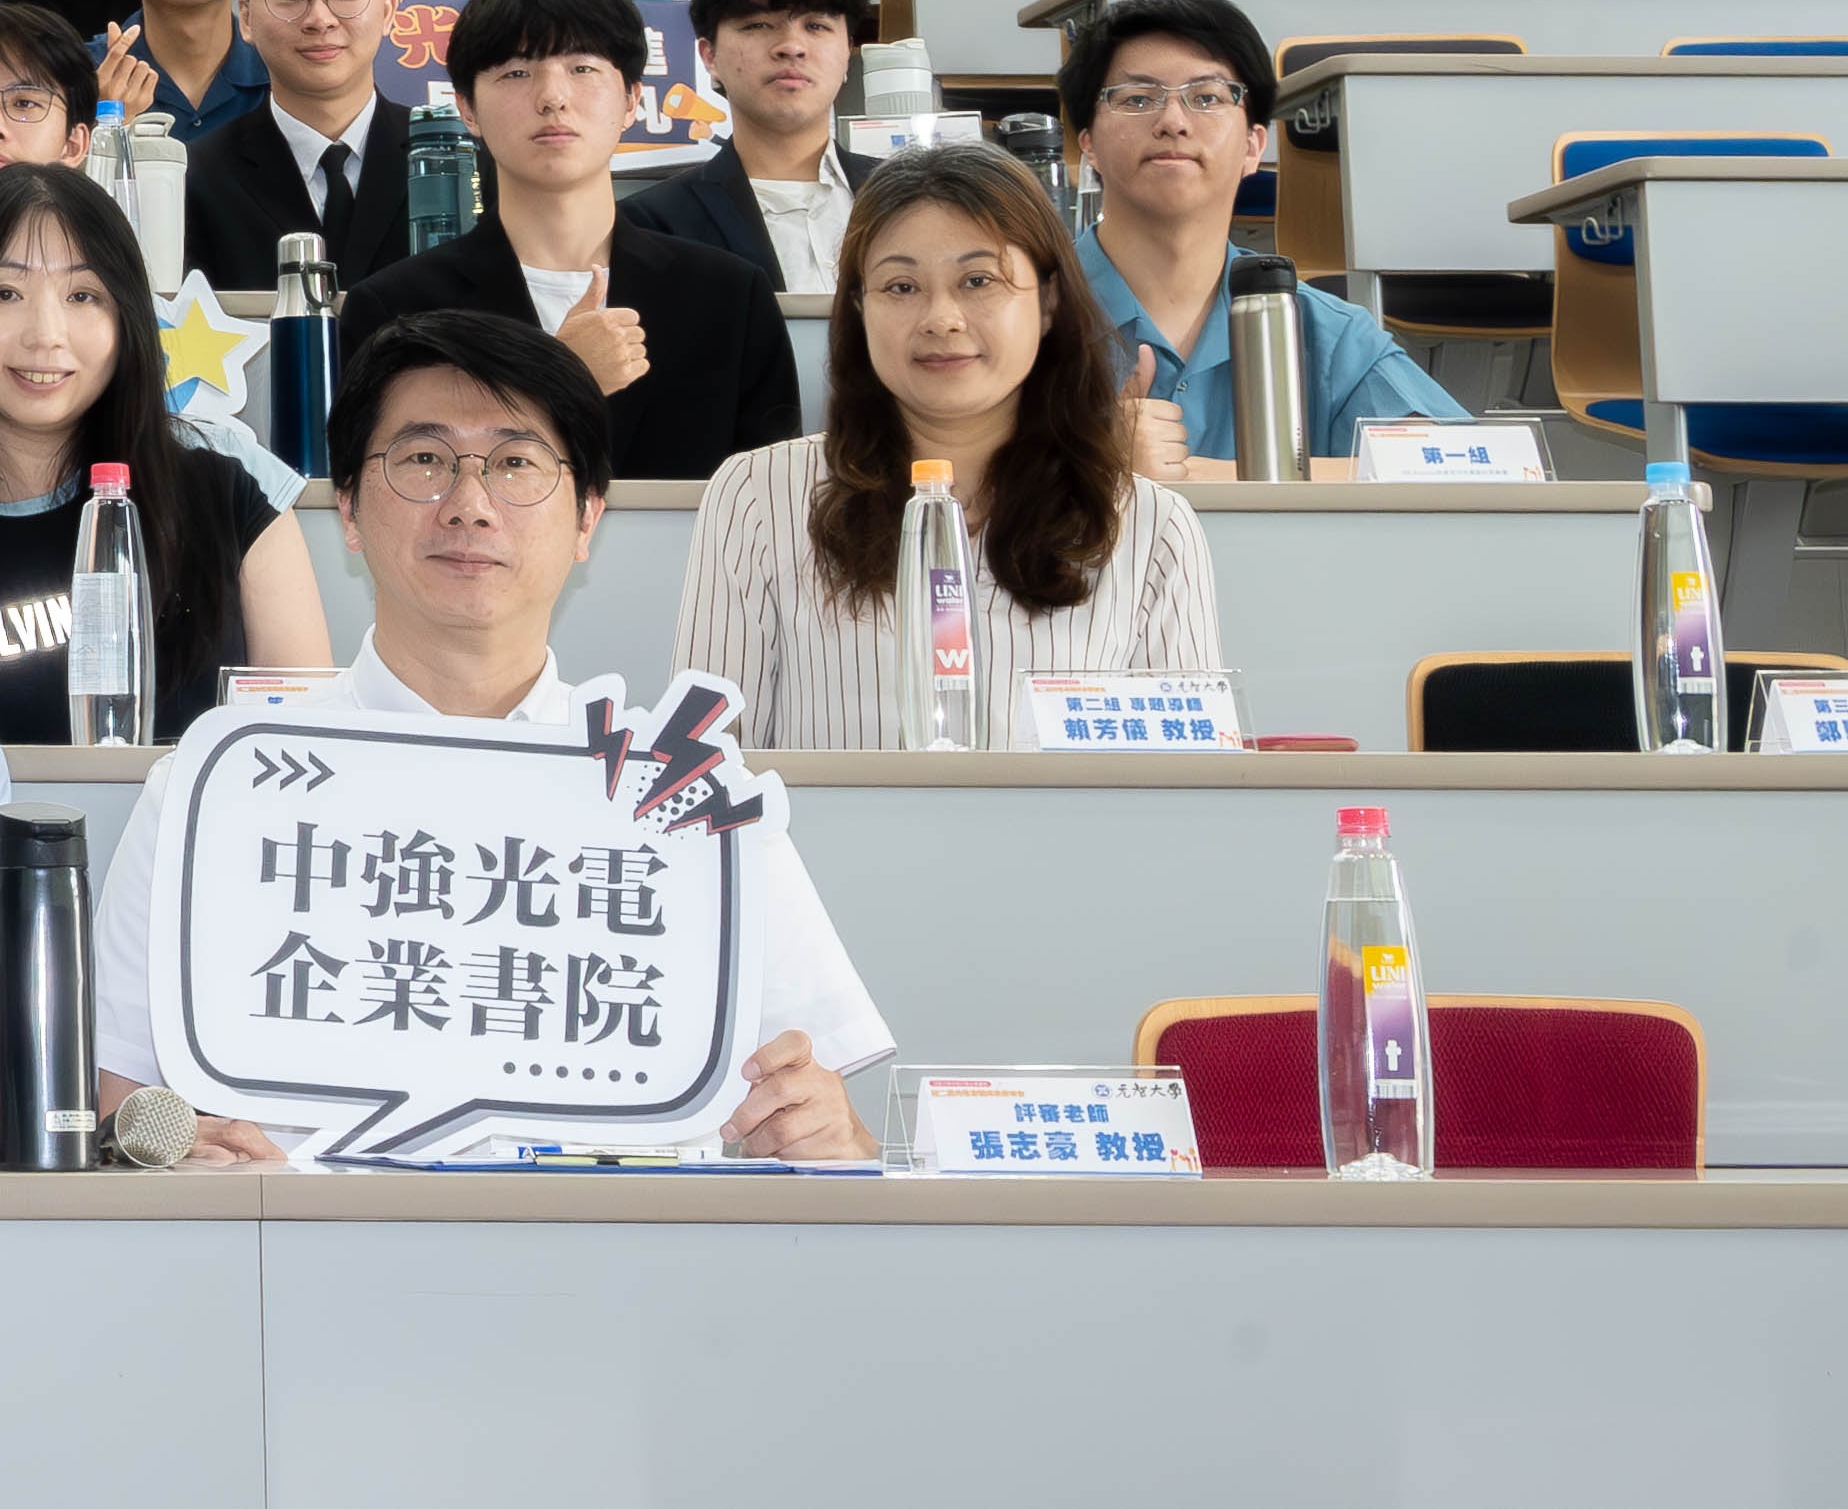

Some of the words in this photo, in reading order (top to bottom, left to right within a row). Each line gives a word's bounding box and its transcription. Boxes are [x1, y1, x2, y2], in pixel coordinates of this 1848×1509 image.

[1421, 446, 1492, 465] 第一組
[1065, 696, 1122, 712] 第二組
[1160, 717, 1217, 742] 教授
[259, 821, 670, 936] 中強光電
[248, 930, 666, 1048] 企業書院
[1013, 1103, 1110, 1124] 評審老師
[968, 1130, 1080, 1162] 張志豪
[1094, 1131, 1167, 1163] 教授
